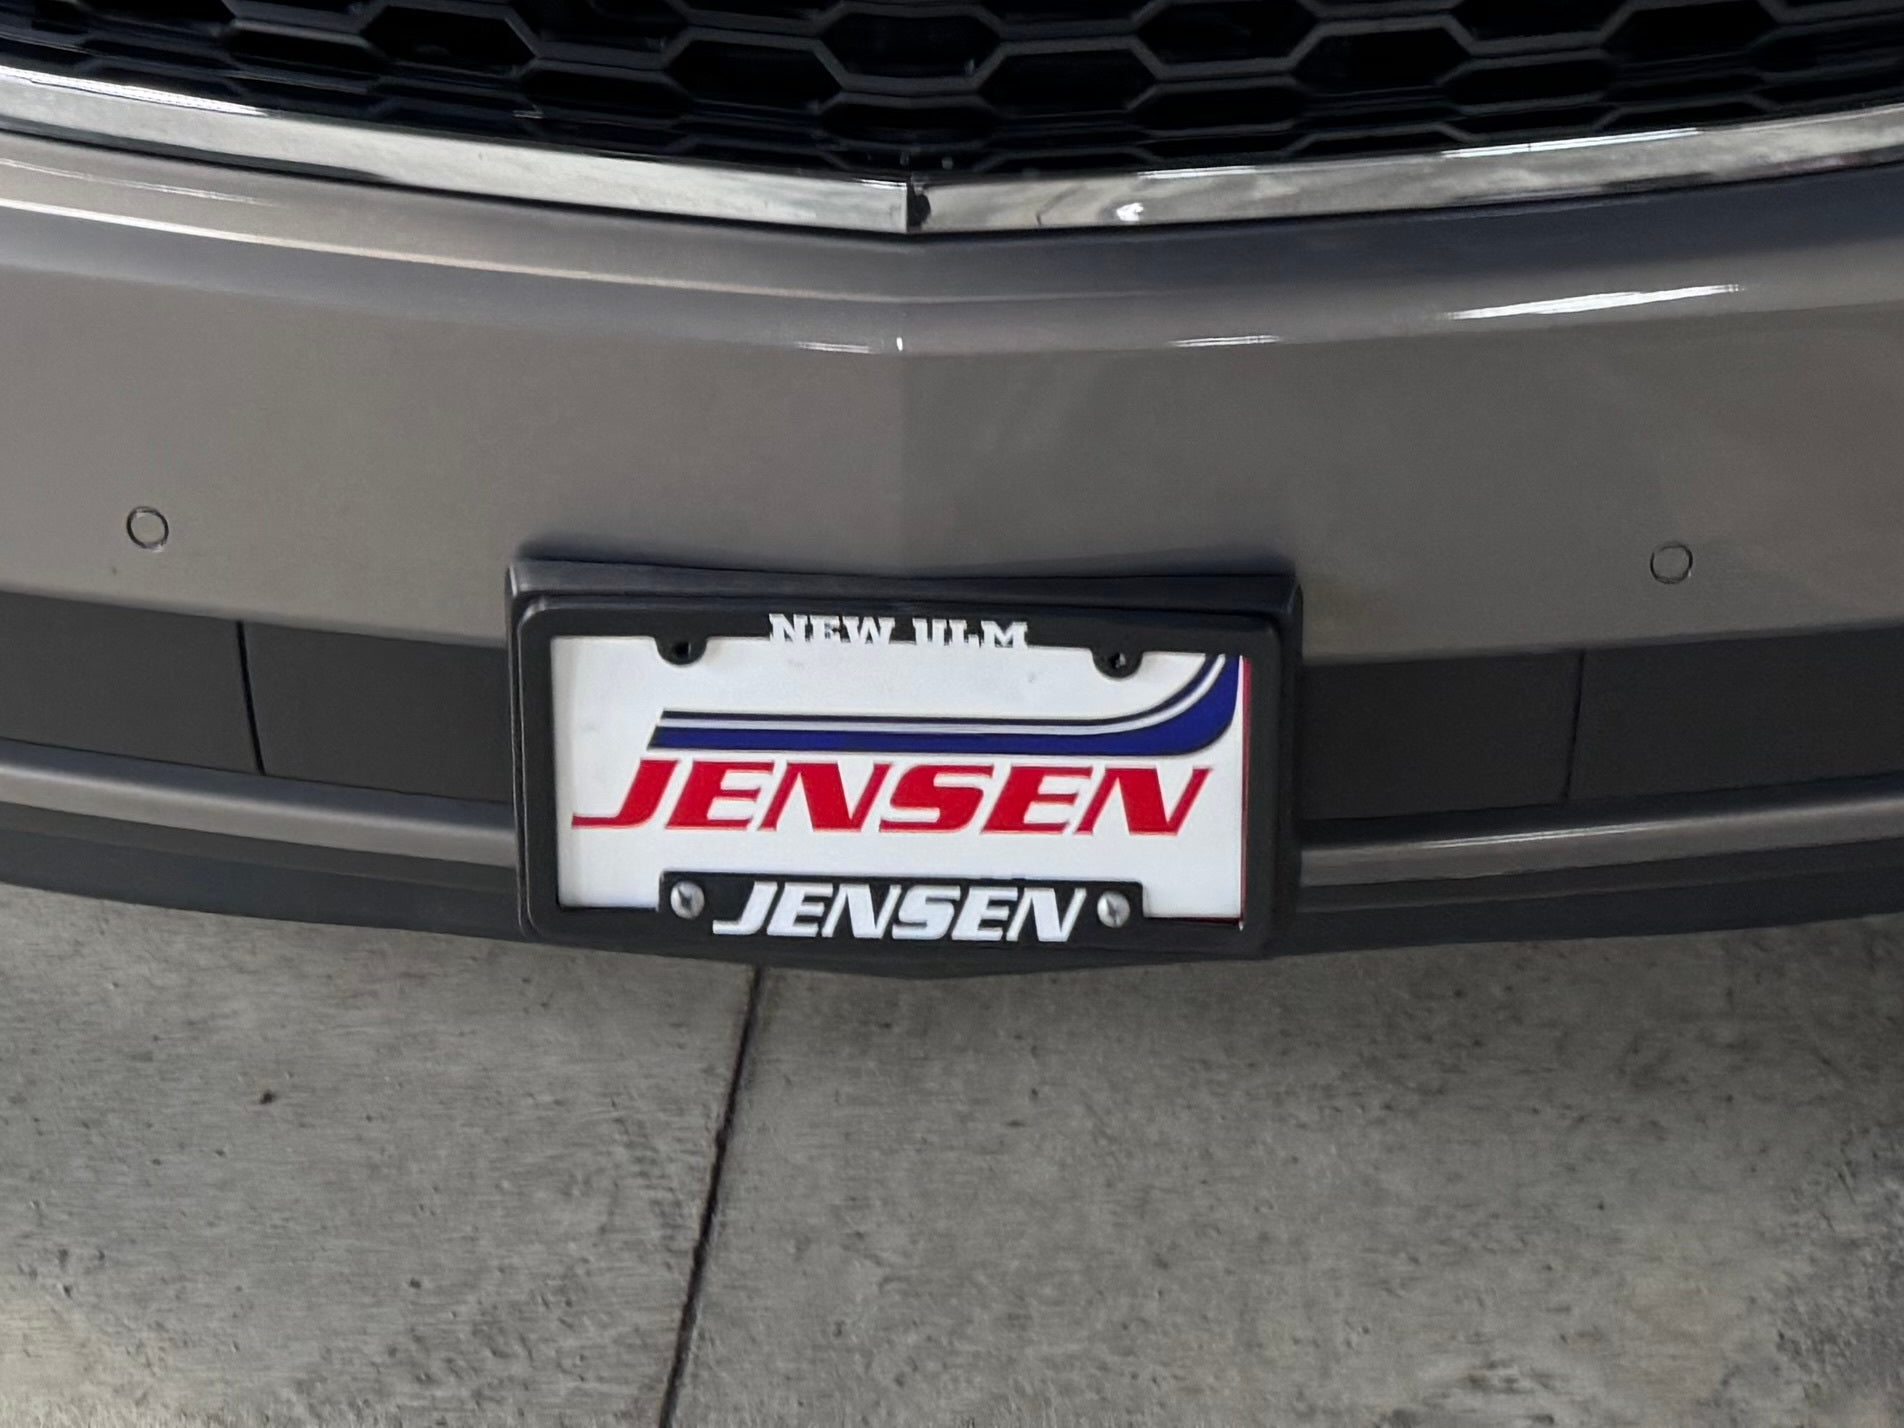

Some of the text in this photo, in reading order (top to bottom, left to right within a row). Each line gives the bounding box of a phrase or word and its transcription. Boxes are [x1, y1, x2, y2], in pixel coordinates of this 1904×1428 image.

[768, 613, 1029, 650] NEW ULM
[571, 757, 1213, 836] JENSEN
[712, 880, 1087, 942] JENSEN
